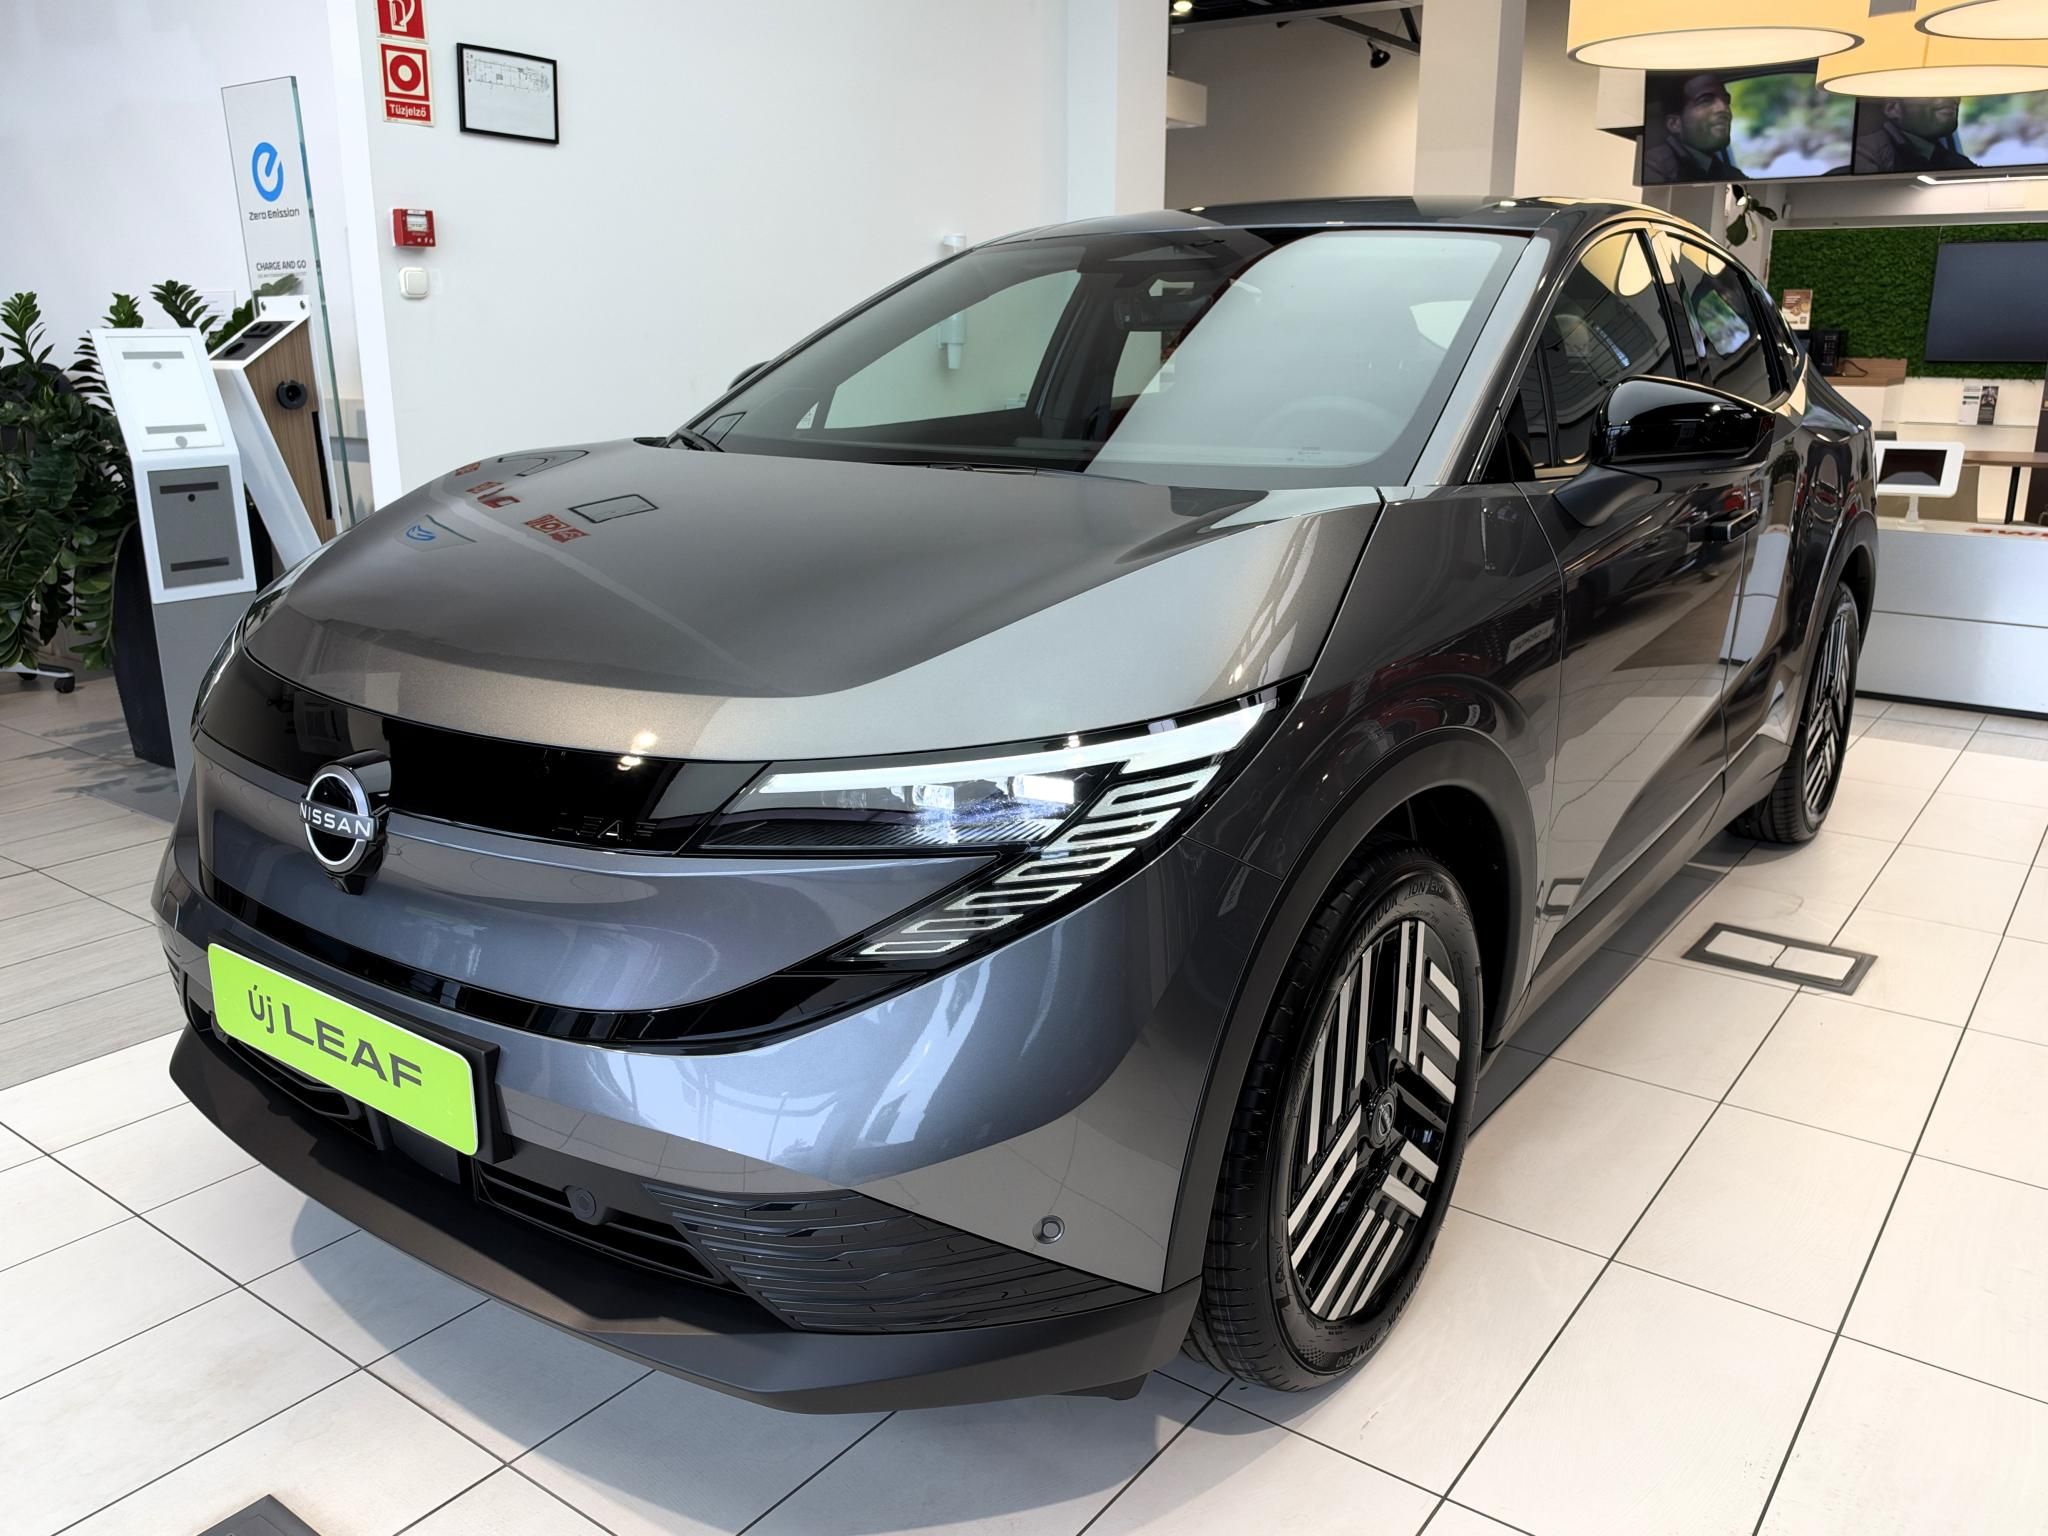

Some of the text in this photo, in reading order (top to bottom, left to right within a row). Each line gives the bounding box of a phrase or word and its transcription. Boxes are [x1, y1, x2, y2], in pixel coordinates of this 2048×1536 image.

[249, 207, 300, 221] Zero Emission
[256, 259, 307, 271] CHARGE AND GO
[300, 801, 371, 838] NISSAN
[248, 984, 422, 1088] Új LEAF
